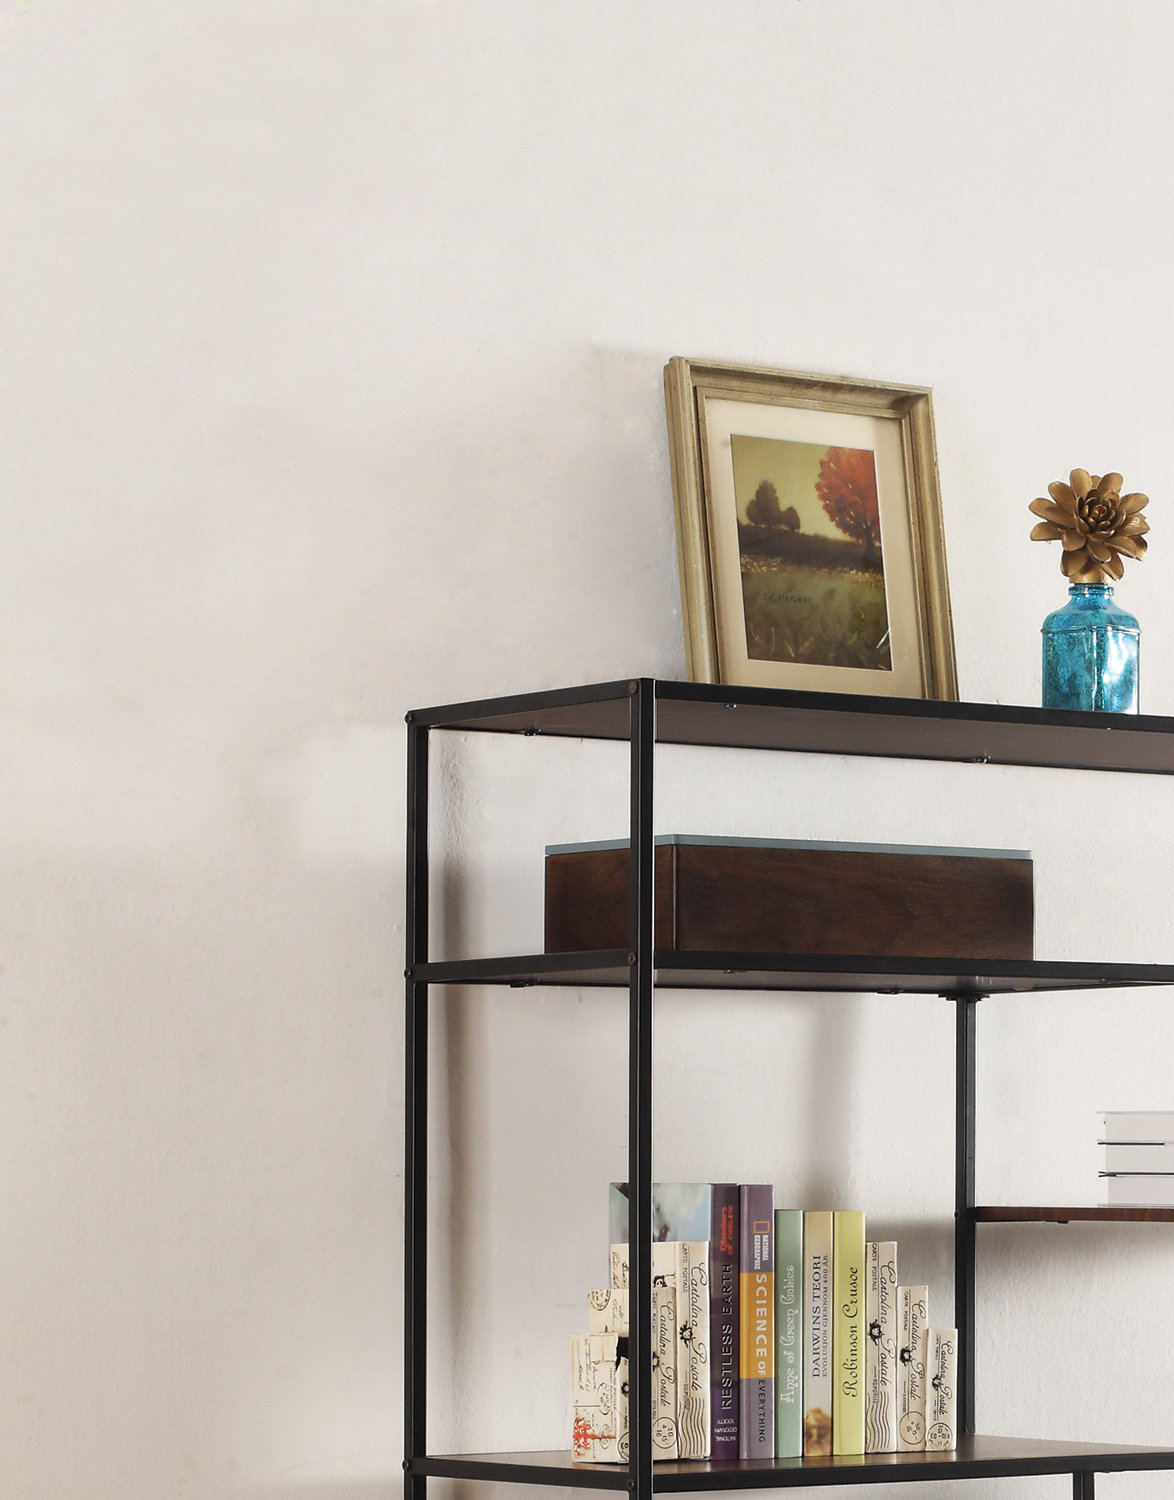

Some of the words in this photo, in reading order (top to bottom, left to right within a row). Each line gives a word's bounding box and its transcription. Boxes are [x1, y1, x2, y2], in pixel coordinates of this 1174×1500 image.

[690, 1262, 707, 1327] Cartolina
[721, 1264, 733, 1316] EARTH
[780, 1264, 795, 1305] Gables
[812, 1255, 821, 1302] TEORI
[842, 1266, 858, 1319] Crusoe
[880, 1260, 896, 1324] Cartolina
[756, 1274, 767, 1358] SCIENCE
[780, 1308, 799, 1346] Green
[812, 1305, 821, 1377] DARWINS
[911, 1299, 926, 1351] Cartolina
[721, 1324, 733, 1410] RESTLESS
[757, 1361, 766, 1376] OF
[783, 1350, 795, 1364] of
[842, 1324, 858, 1398] Robinson
[880, 1335, 896, 1386] Postale
[758, 1379, 766, 1443] EVERYTHING
[780, 1368, 798, 1404] Anne
